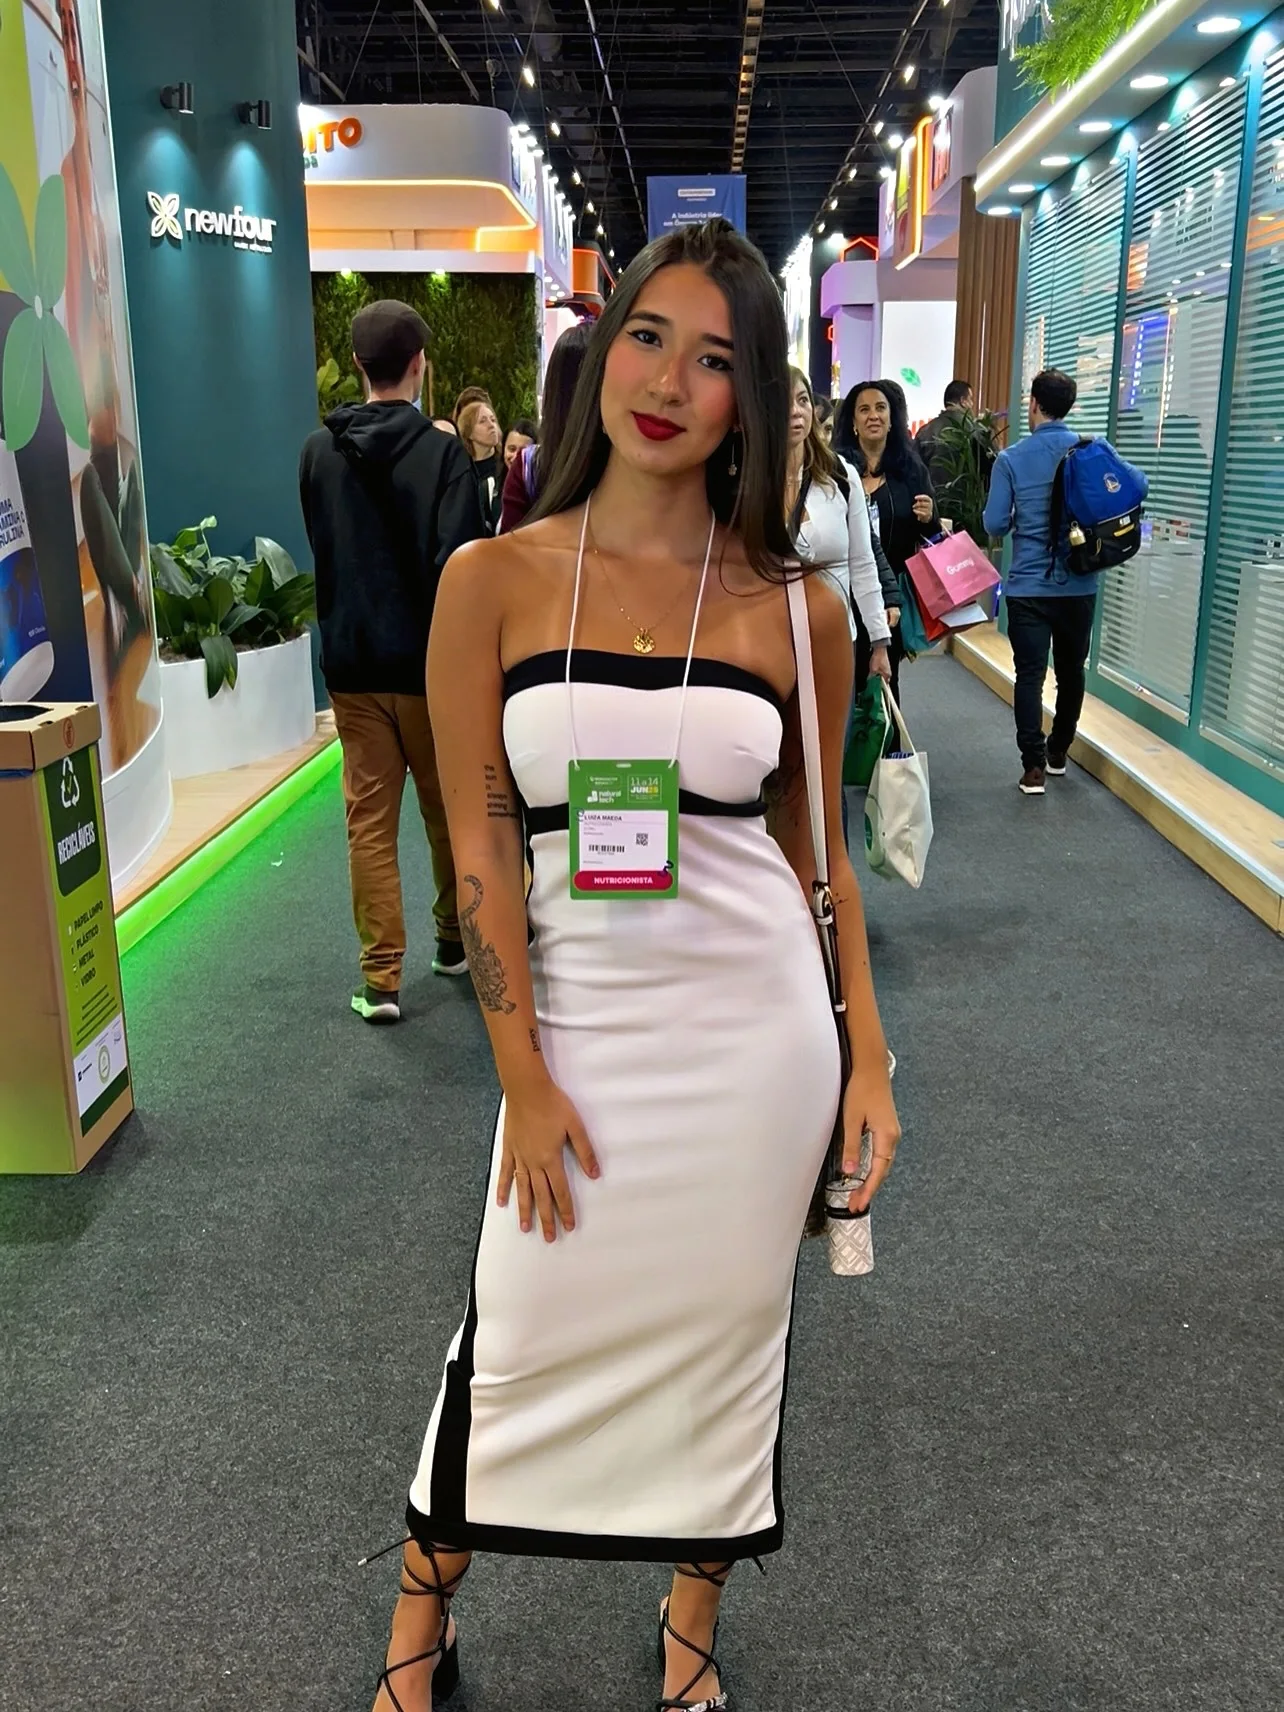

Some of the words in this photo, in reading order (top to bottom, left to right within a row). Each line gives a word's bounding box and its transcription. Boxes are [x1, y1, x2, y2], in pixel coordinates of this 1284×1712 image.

[184, 205, 277, 242] newfour
[57, 821, 95, 865] RECICLÁVEIS
[593, 876, 653, 884] NUTRICIONISTA
[74, 912, 90, 931] PAPEL
[76, 923, 99, 950] PLÁSTICO
[79, 948, 95, 969] METAL
[81, 967, 97, 987] VIDRO
